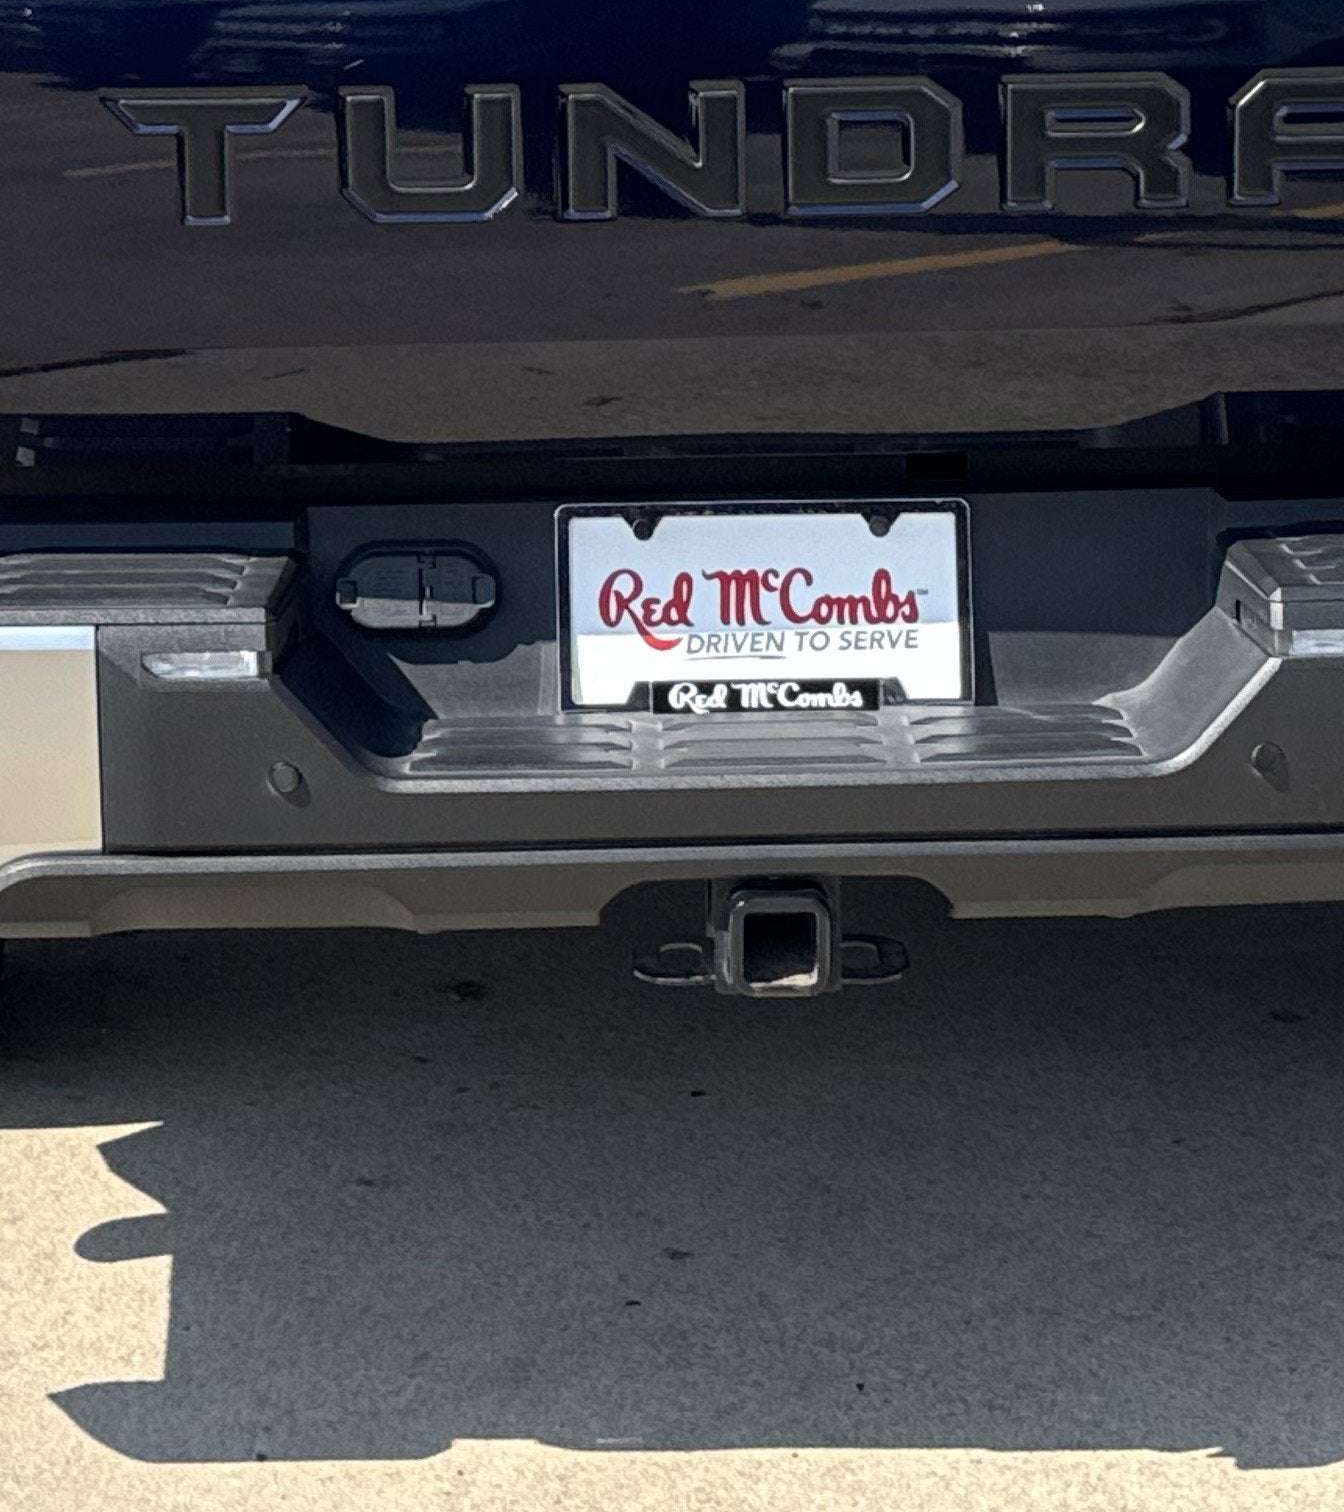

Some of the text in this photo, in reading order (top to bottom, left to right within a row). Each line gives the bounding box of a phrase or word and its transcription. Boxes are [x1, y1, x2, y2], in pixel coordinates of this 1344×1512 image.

[598, 567, 919, 651] Red McCombs
[686, 629, 919, 654] DRIVEN TO SERVE
[668, 682, 863, 714] Red McCombs
